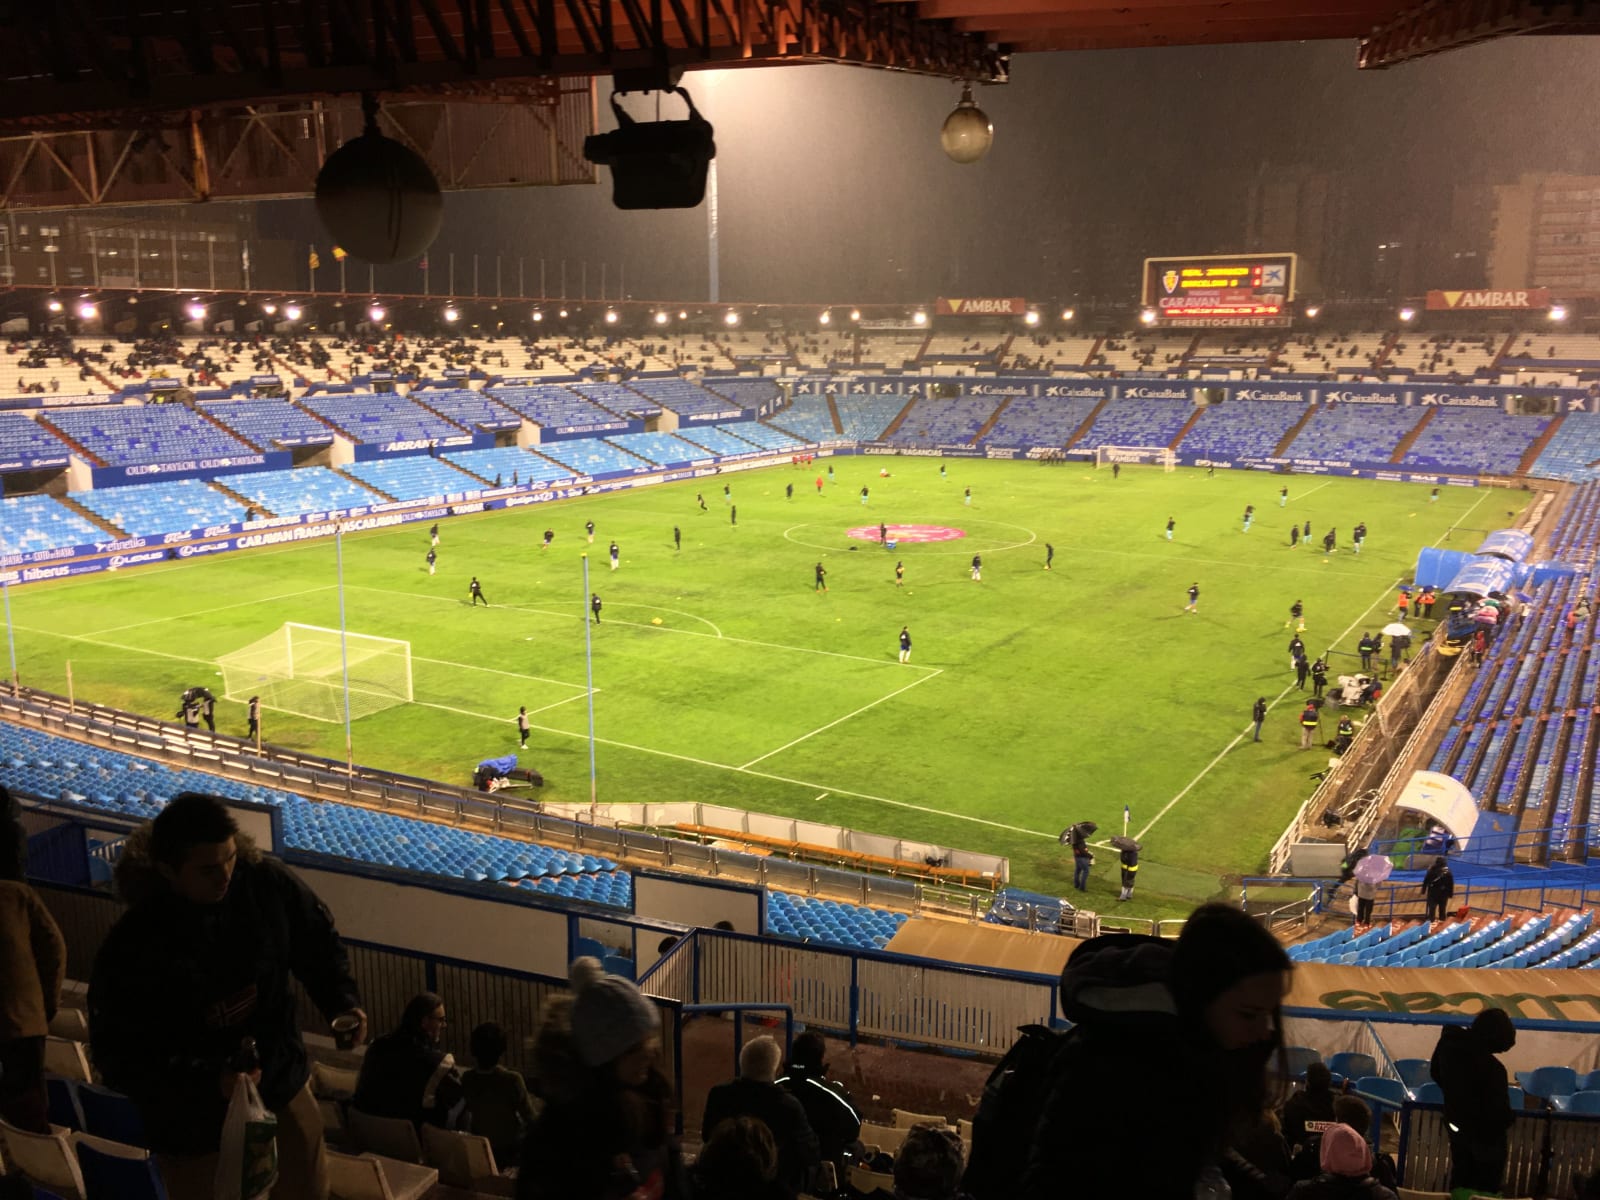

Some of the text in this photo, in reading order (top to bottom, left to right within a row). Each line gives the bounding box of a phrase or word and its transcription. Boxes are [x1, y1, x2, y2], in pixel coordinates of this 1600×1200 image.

[1460, 291, 1530, 307] AMBAR
[962, 300, 1012, 313] AMBAR
[983, 385, 1028, 395] CaixaBank
[1059, 386, 1106, 397] CaixaBank
[1138, 387, 1188, 399] CaixaBank
[1250, 389, 1304, 401] CaixaBank
[1341, 391, 1398, 403] CaixaBank
[1439, 393, 1499, 406] CaixaBank
[125, 460, 197, 476] OLD TAYLOR
[200, 455, 265, 469] OLD TAYLOR
[236, 530, 293, 548] CARAVAN
[23, 565, 70, 581] hiberus
